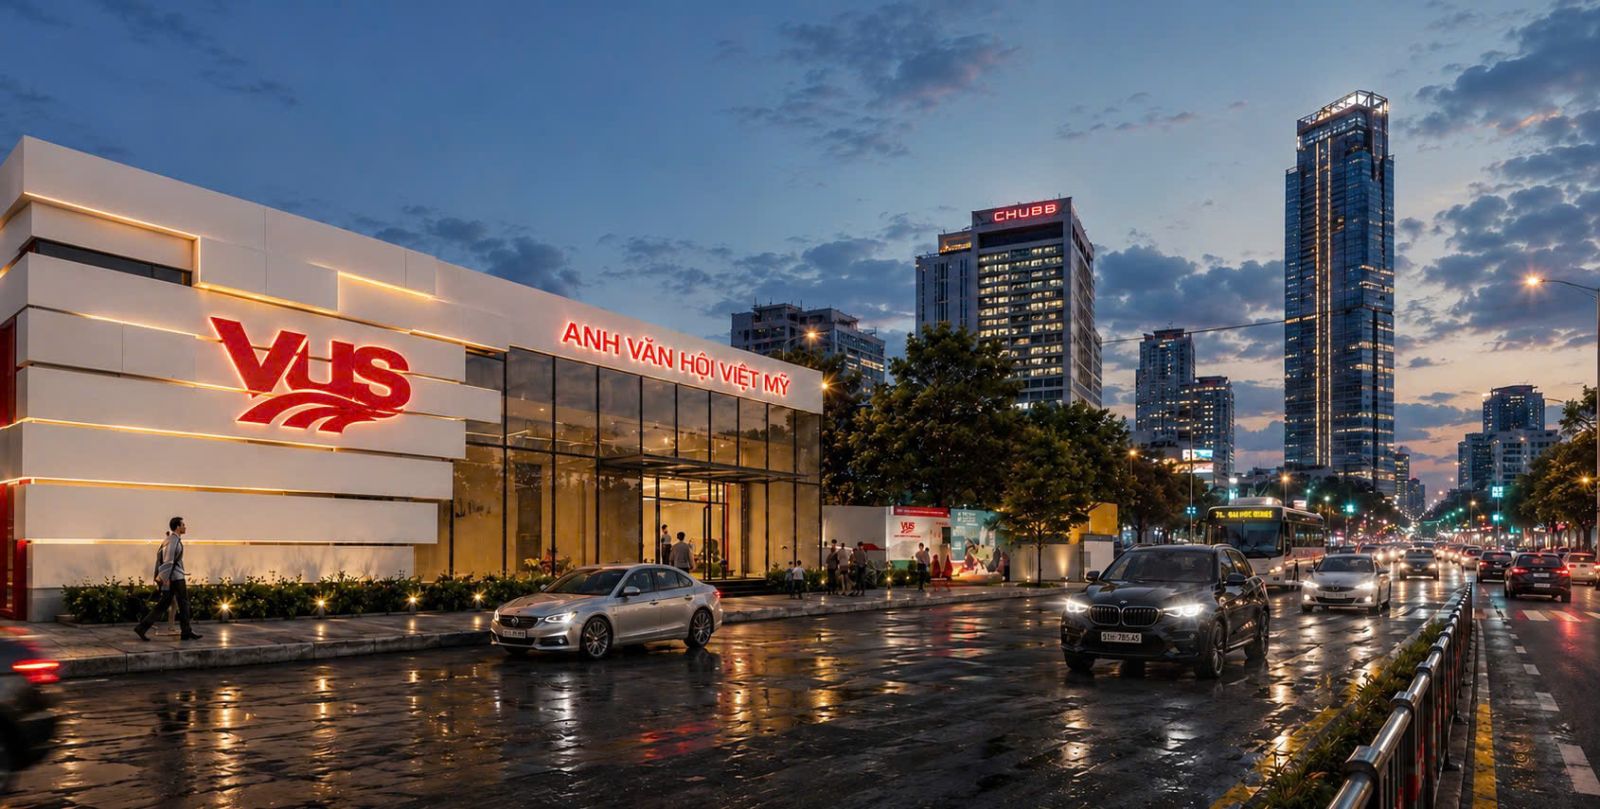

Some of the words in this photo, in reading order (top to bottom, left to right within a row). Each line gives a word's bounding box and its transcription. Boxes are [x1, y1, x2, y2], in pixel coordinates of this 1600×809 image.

[994, 204, 1056, 222] CHUBB
[210, 316, 412, 411] VUS
[562, 322, 620, 355] ANH
[626, 336, 673, 369] VĂN
[680, 352, 715, 381] HỘI
[719, 362, 759, 391] VIỆT
[764, 374, 791, 396] MỸ
